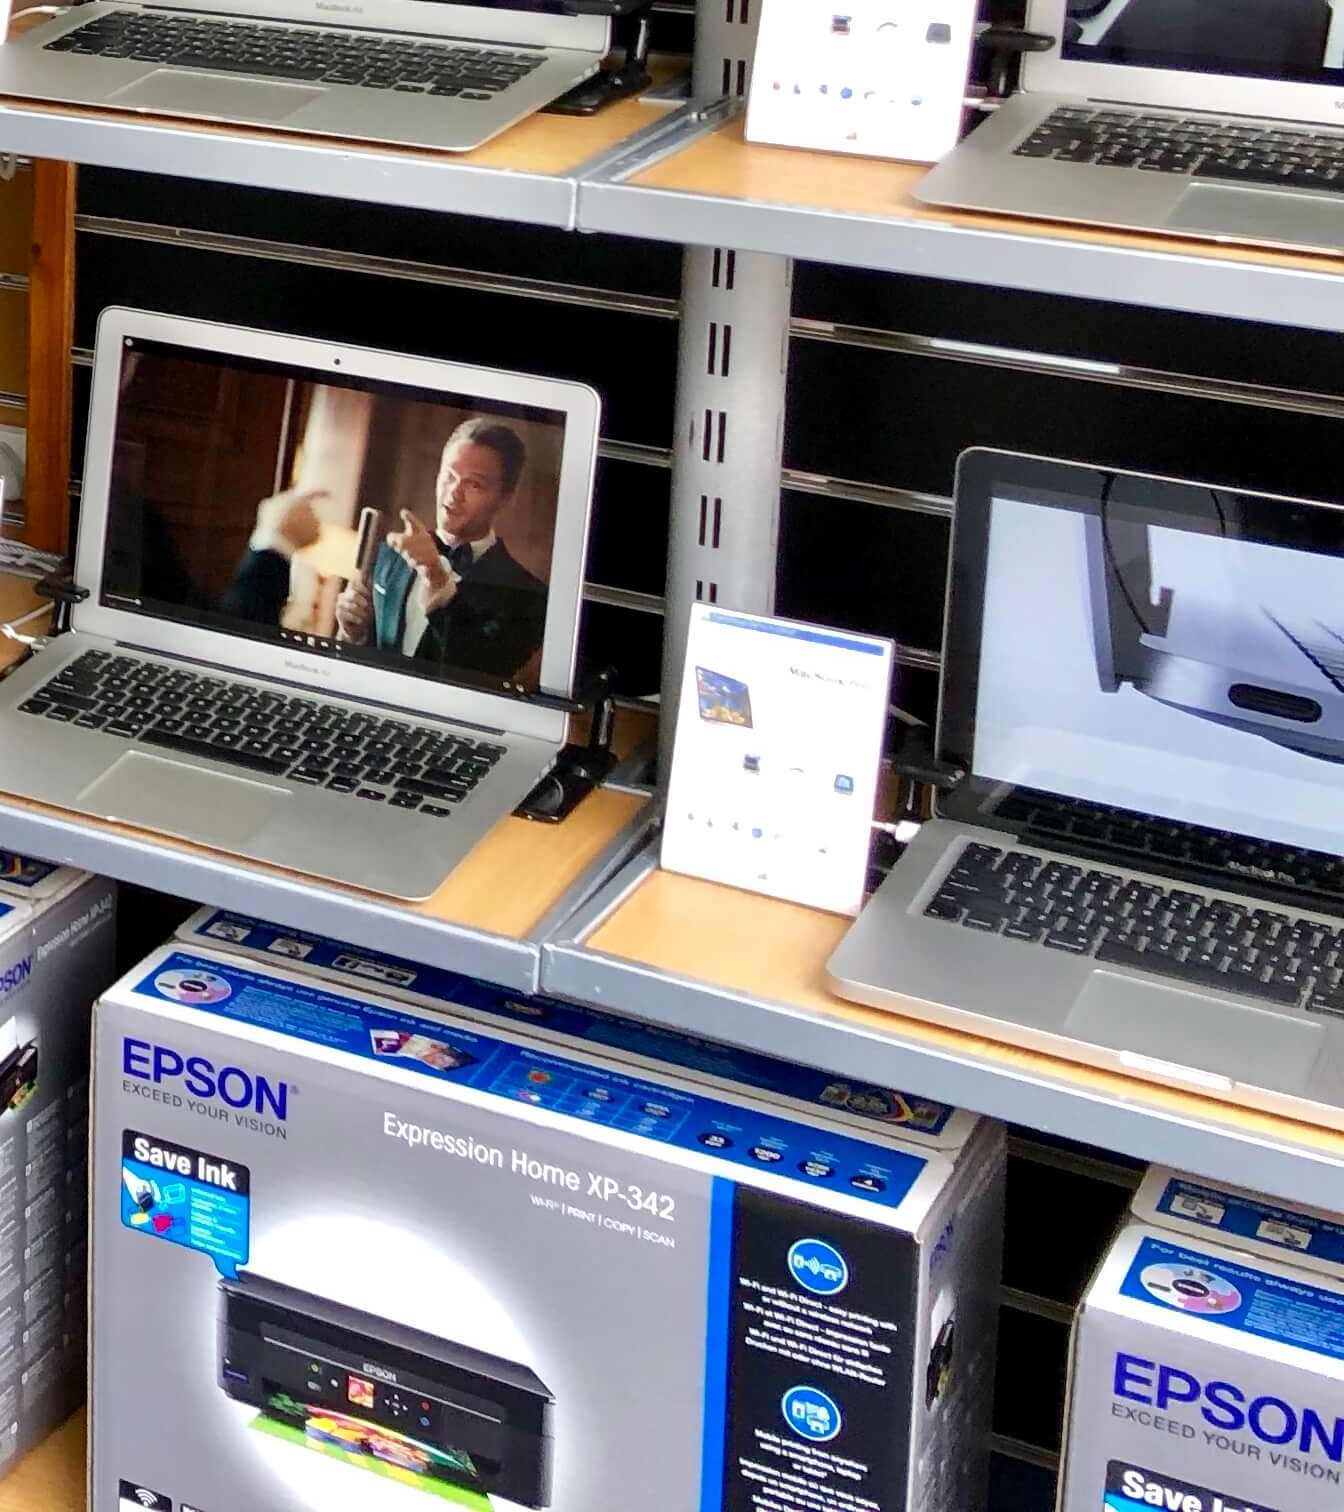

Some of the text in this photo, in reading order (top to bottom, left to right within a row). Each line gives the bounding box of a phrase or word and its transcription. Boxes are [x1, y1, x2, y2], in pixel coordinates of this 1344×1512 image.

[123, 1036, 289, 1122] EPSON
[122, 1079, 288, 1140] EXCEED YOUR VISION
[133, 1137, 238, 1191] Save Ink
[383, 1111, 676, 1222] Expression Home XP-342
[602, 1217, 636, 1238] COPY
[642, 1228, 676, 1248] SCAN
[1150, 1241, 1175, 1255] For
[1178, 1250, 1210, 1267] best
[1212, 1262, 1262, 1283] results
[1264, 1276, 1315, 1299] always
[363, 1362, 397, 1382] EPSON
[1113, 1351, 1343, 1464] EPSON
[1112, 1402, 1341, 1485] EXCEED YOUR VISION
[1121, 1470, 1203, 1512] Save
